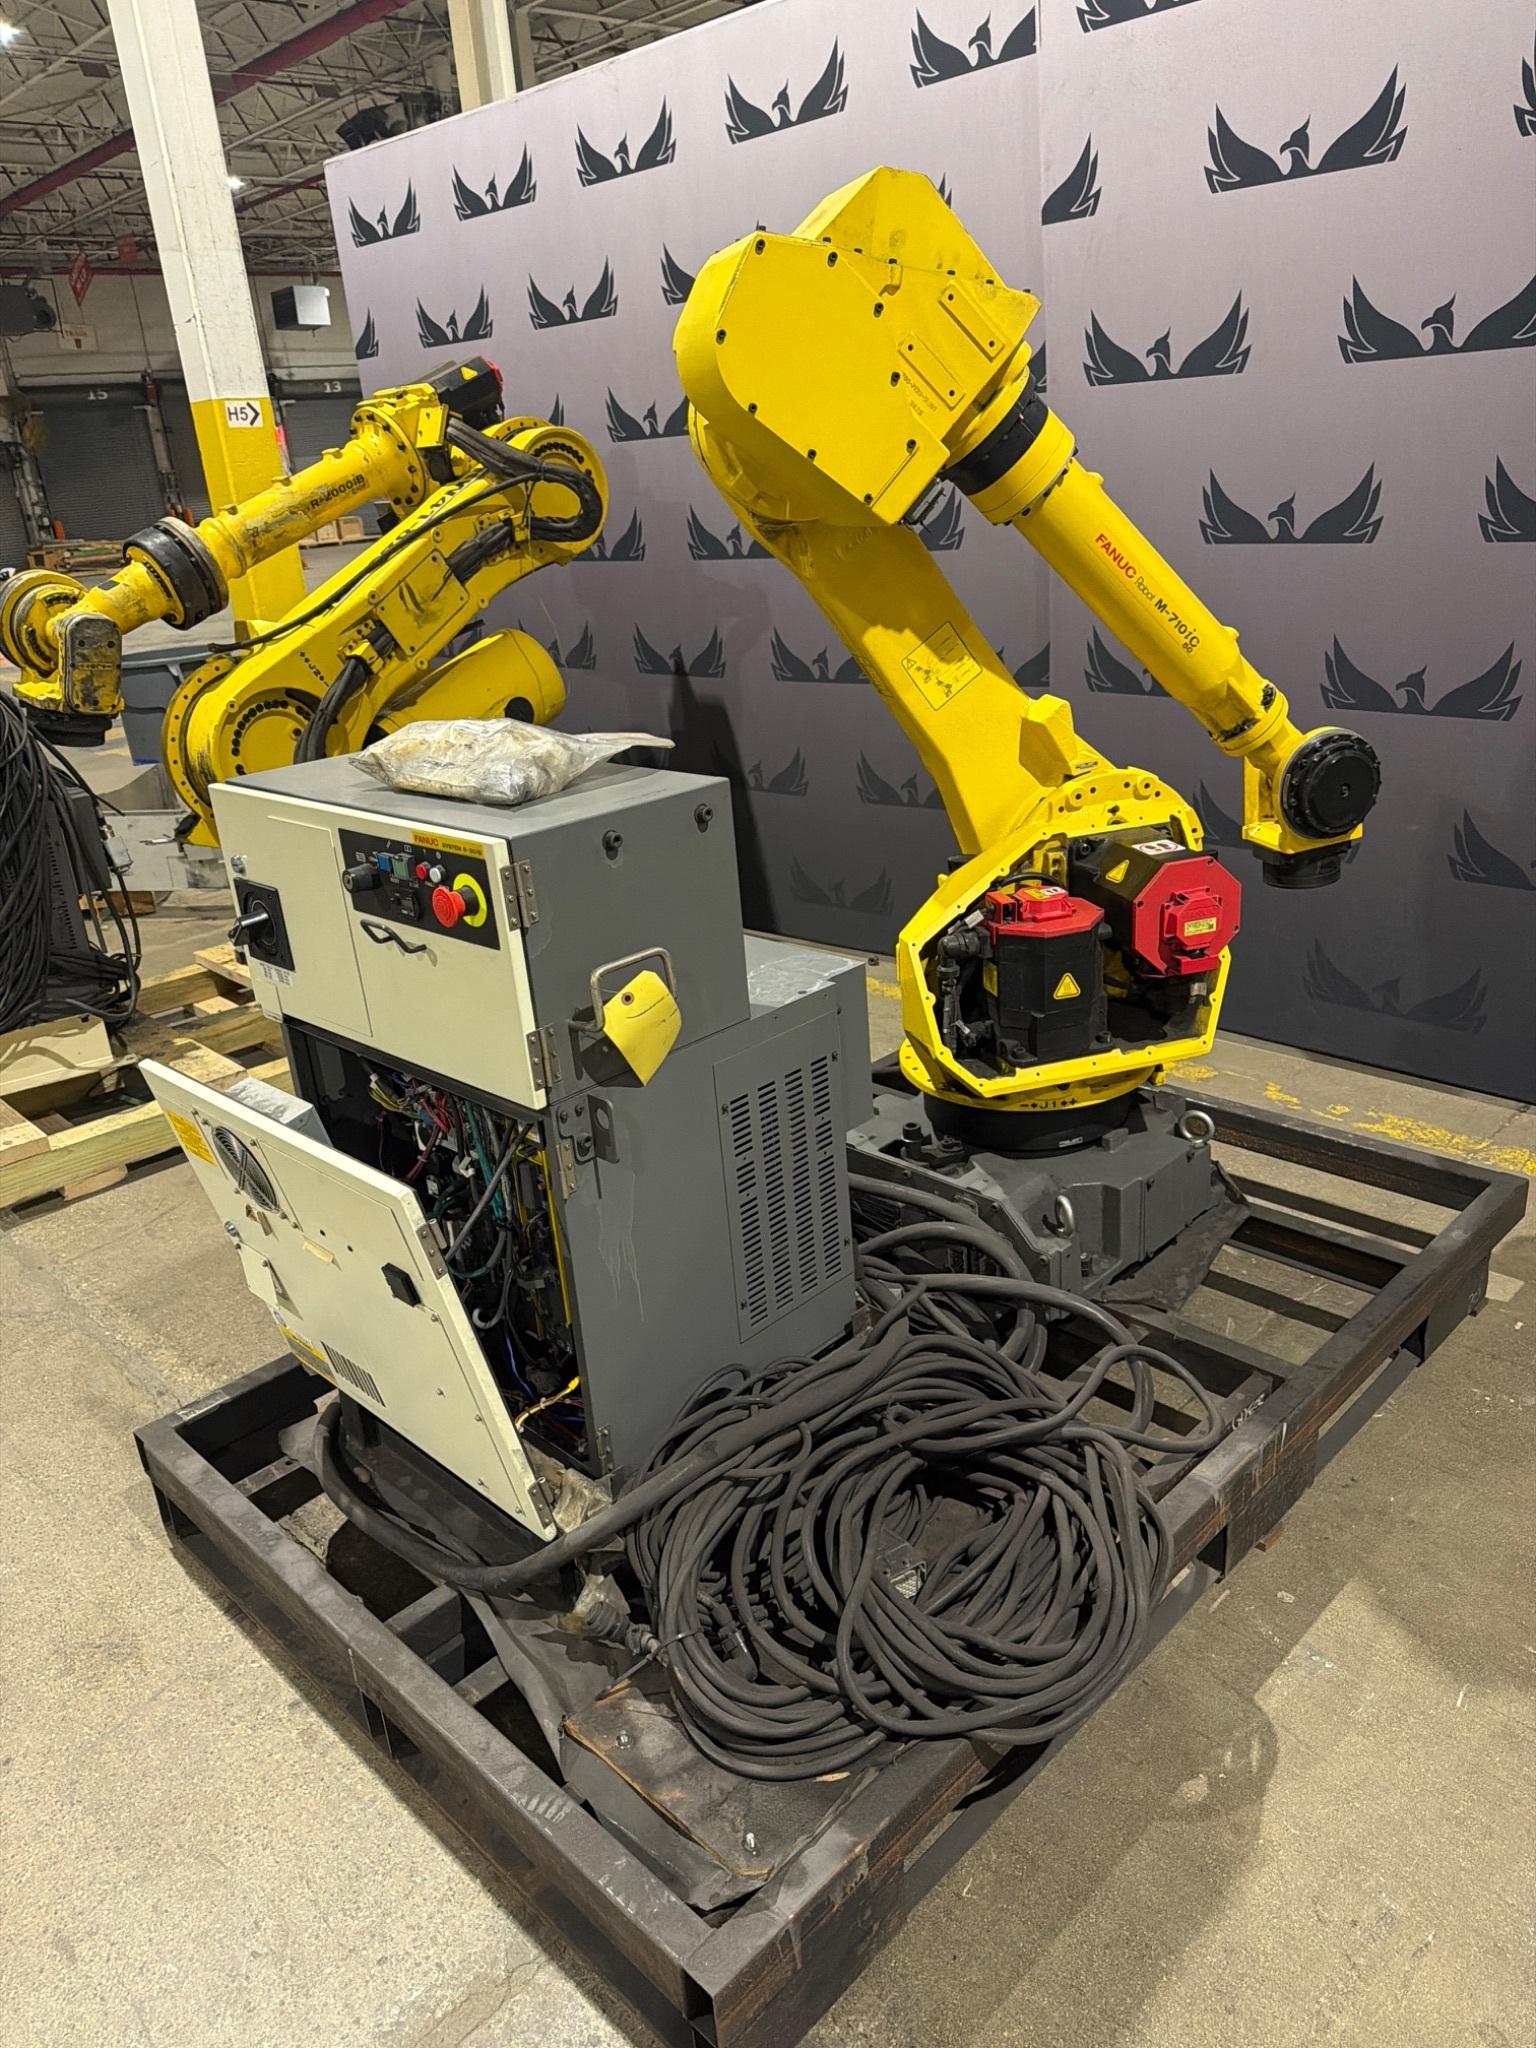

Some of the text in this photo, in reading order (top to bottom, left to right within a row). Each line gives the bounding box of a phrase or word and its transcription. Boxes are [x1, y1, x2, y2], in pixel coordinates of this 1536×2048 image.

[323, 381, 342, 393] 13
[227, 406, 249, 421] H5
[1095, 533, 1200, 648] FANUC Robot M-710iC
[414, 834, 439, 847] FANUC
[1039, 1100, 1056, 1109] J1
